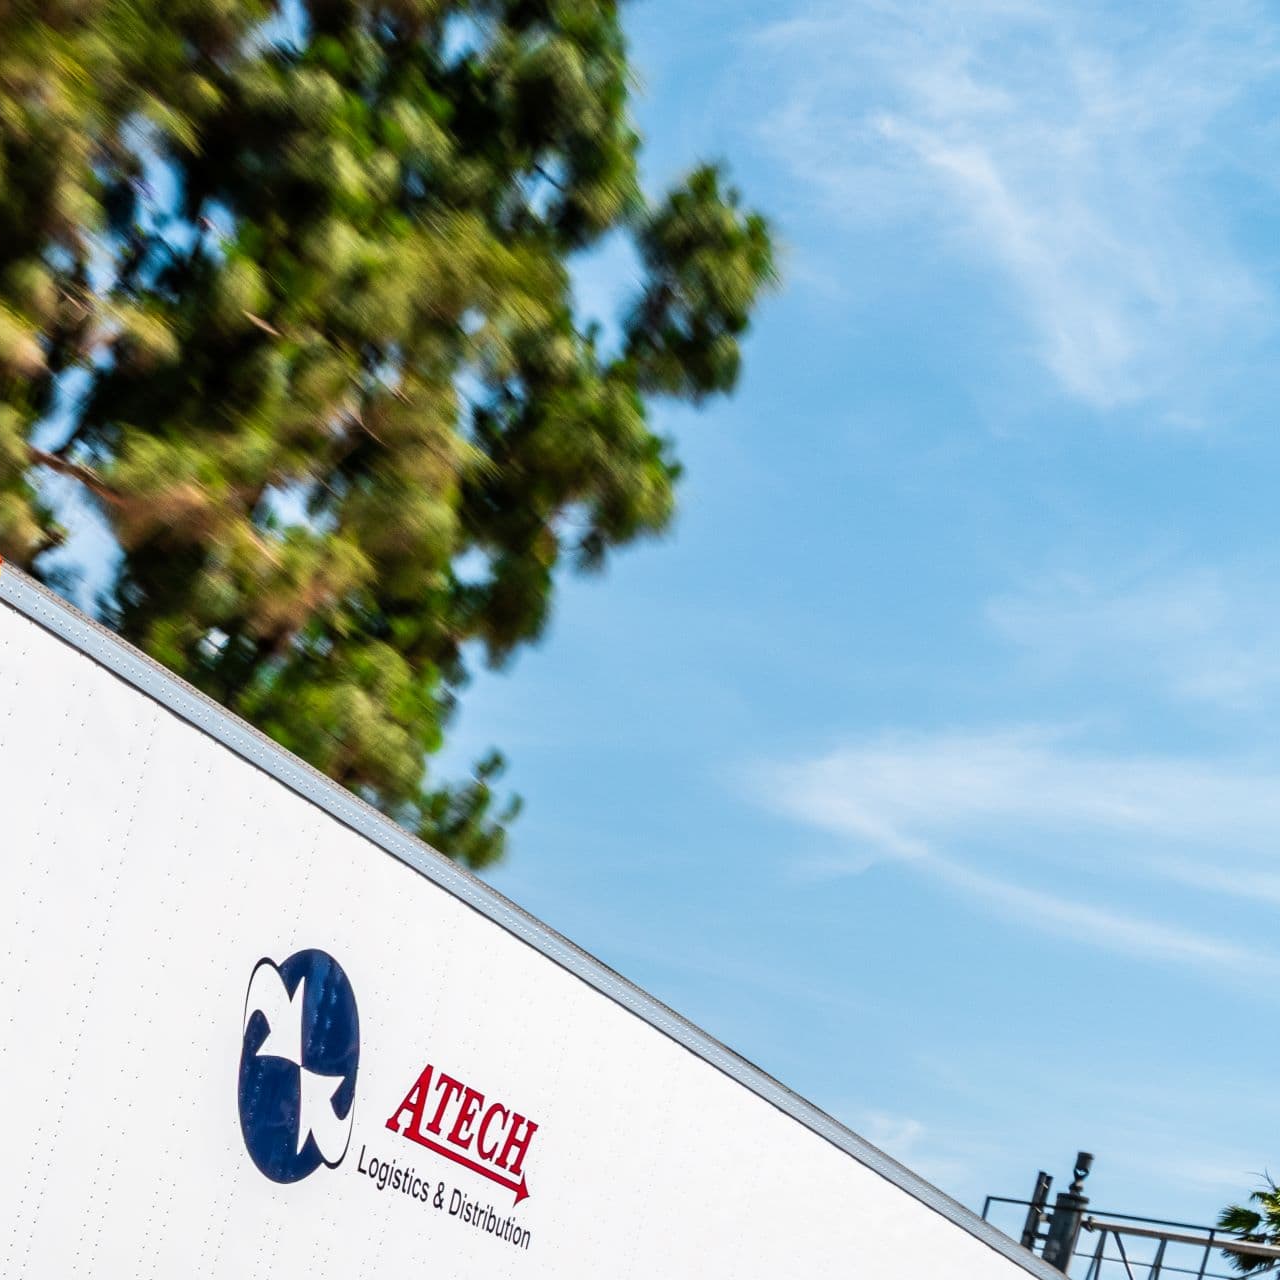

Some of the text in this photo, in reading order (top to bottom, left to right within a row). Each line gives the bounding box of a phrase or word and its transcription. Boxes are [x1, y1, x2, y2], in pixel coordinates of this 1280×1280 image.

[385, 1063, 539, 1176] ATECH
[357, 1144, 532, 1250] Logistics & Distribution
